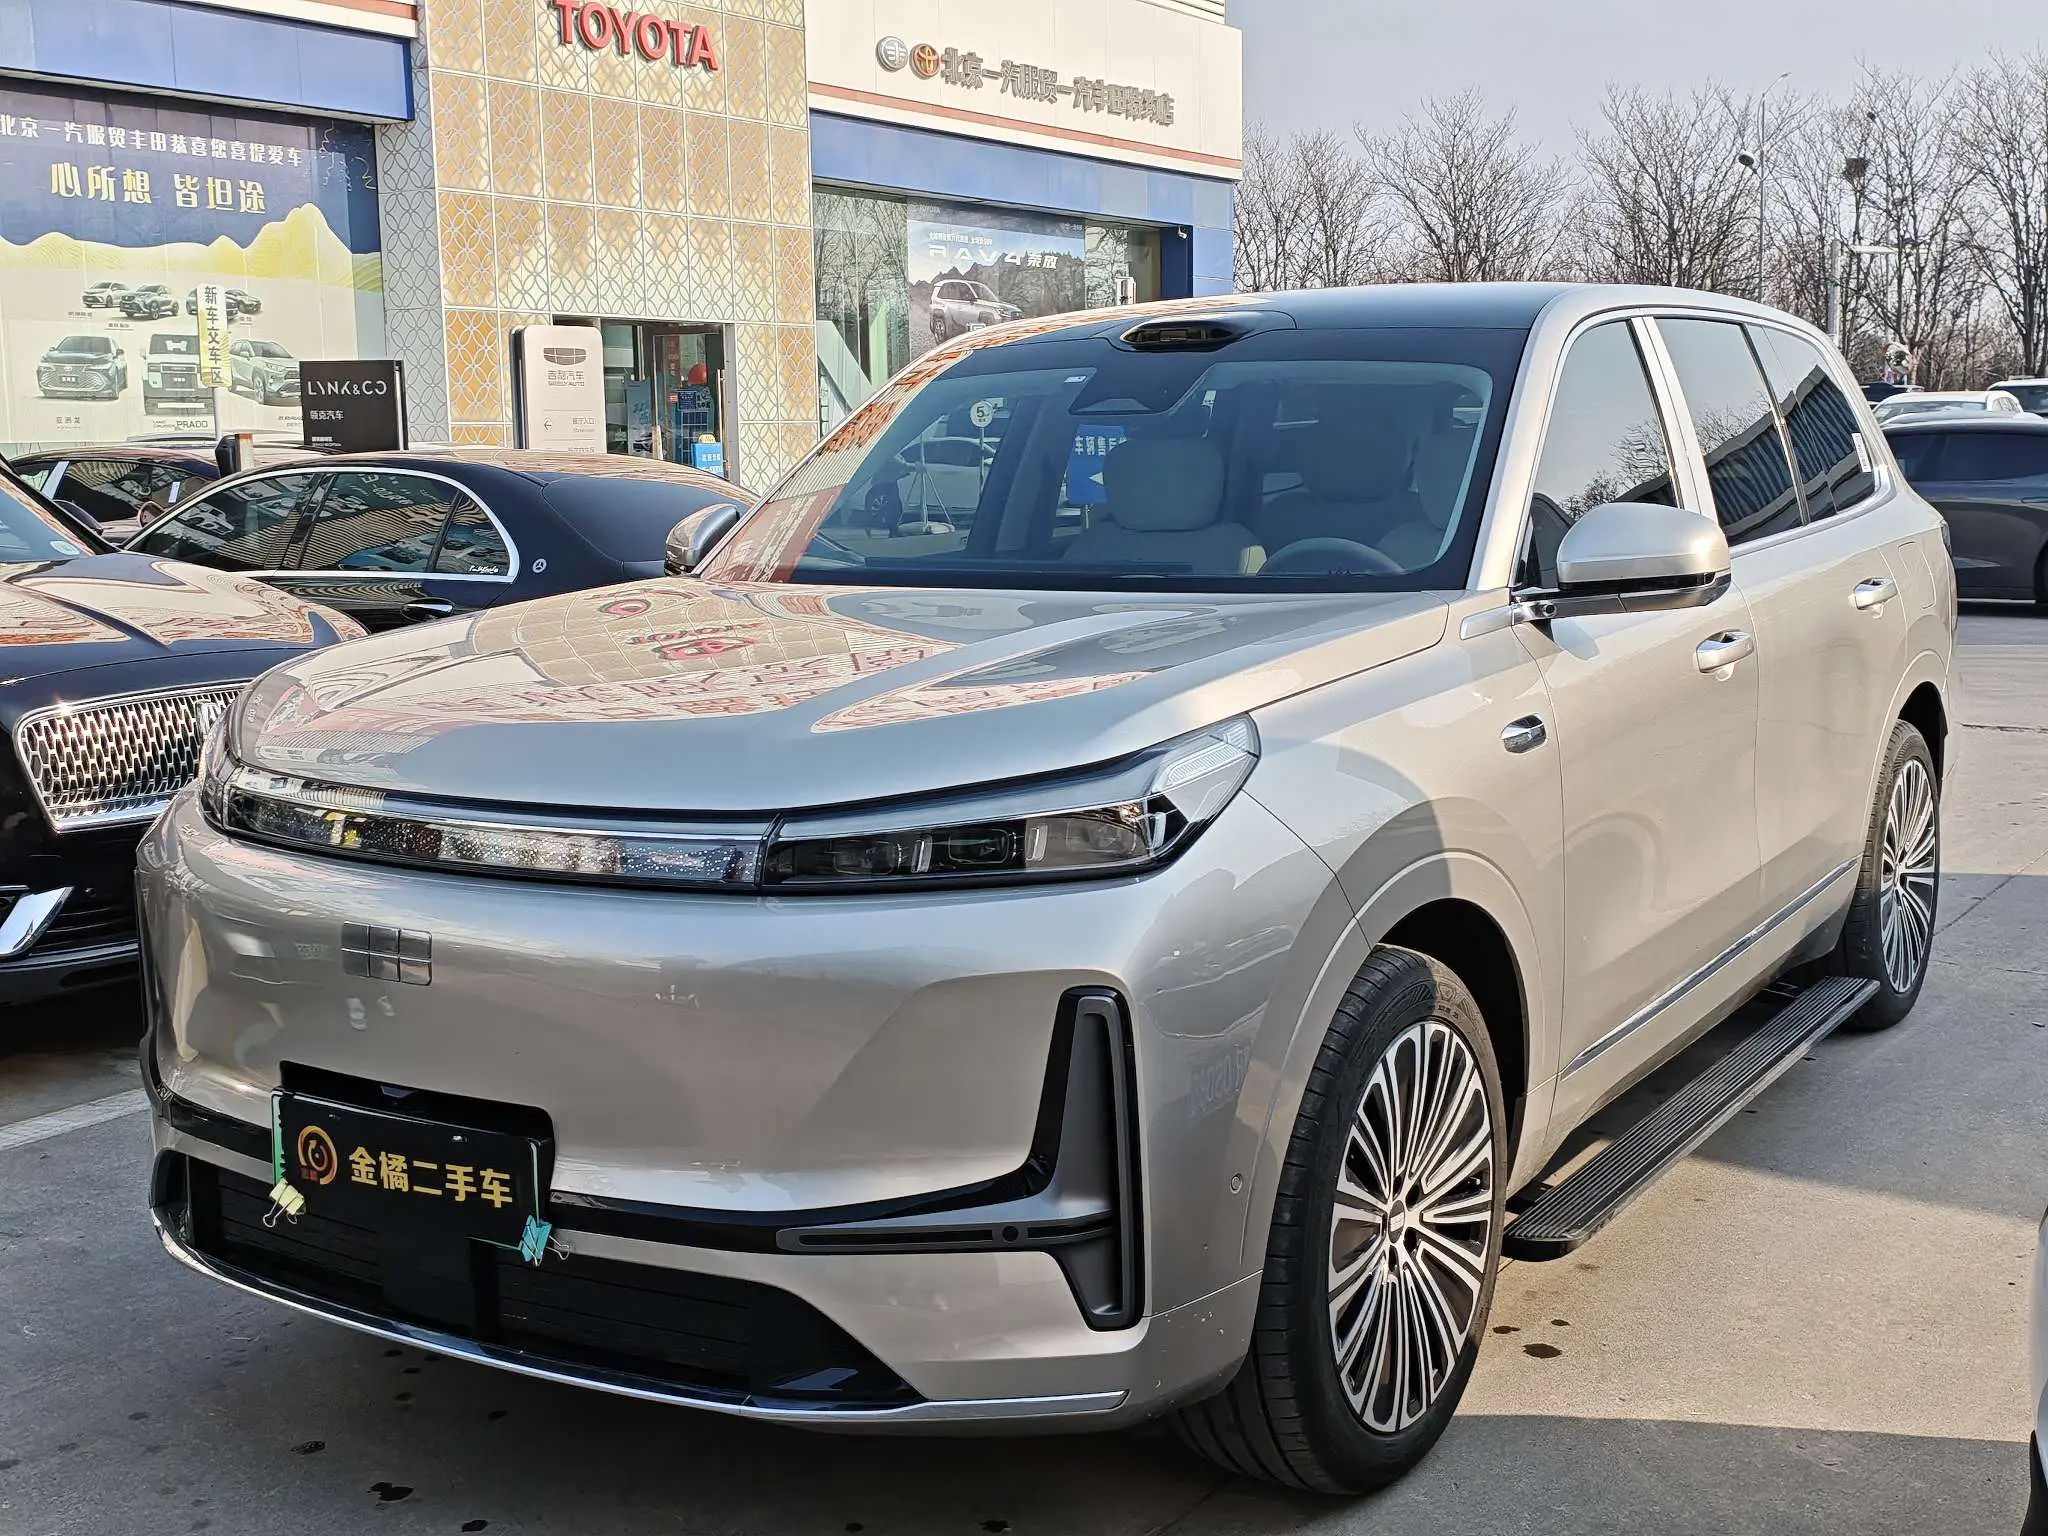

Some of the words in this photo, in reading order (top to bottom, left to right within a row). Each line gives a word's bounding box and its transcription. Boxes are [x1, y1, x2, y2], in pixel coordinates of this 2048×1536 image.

[552, 0, 718, 71] TOYOTA
[51, 162, 152, 204] 心所想
[174, 173, 266, 214] 皆坦途
[204, 286, 224, 384] 新车交车区
[176, 420, 208, 428] PRADO
[976, 405, 986, 418] 5
[1074, 435, 1127, 456] 车辆售后
[349, 1145, 513, 1208] 金橘二手车
